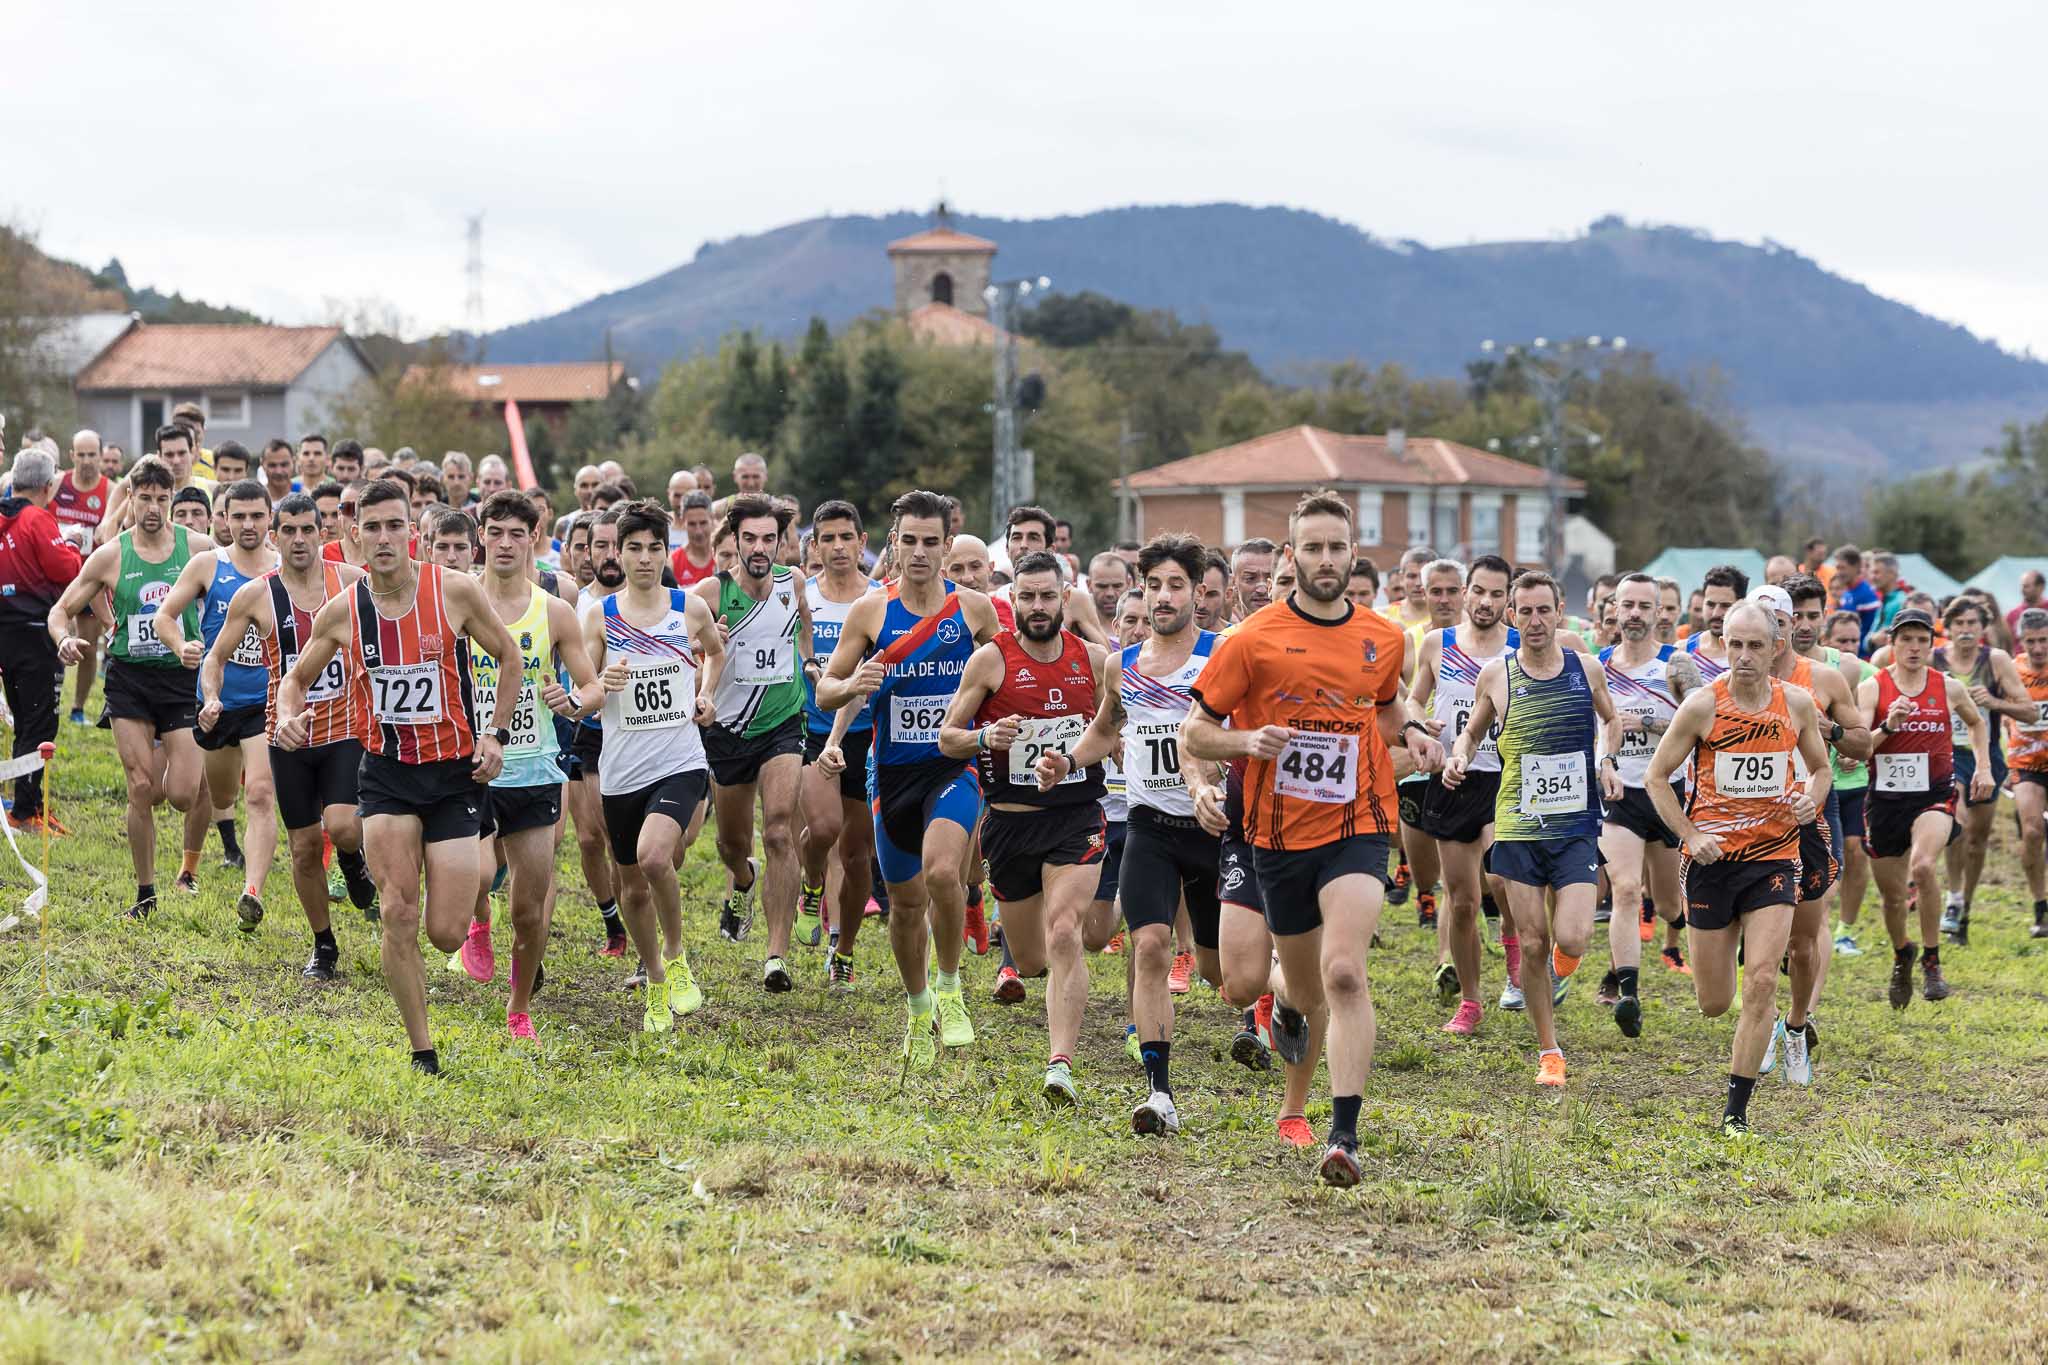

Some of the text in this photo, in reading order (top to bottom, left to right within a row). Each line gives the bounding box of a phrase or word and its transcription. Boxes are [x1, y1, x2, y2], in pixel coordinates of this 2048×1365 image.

[755, 648, 777, 670] 94
[403, 667, 430, 676] LASTRA
[885, 660, 965, 678] VILLA DE NOJA
[375, 677, 435, 714] 722
[634, 679, 673, 712] 665
[625, 710, 688, 726] TORRELAVEGA
[900, 708, 947, 731] 962
[897, 731, 918, 741] VILLA
[919, 731, 930, 741] DE
[1056, 731, 1081, 740] LOREDO
[1282, 750, 1347, 785] 484
[1731, 756, 1774, 781] 795
[1889, 765, 1917, 778] 219
[1536, 775, 1573, 795] 354
[1722, 784, 1780, 794] Amigos del Deporte
